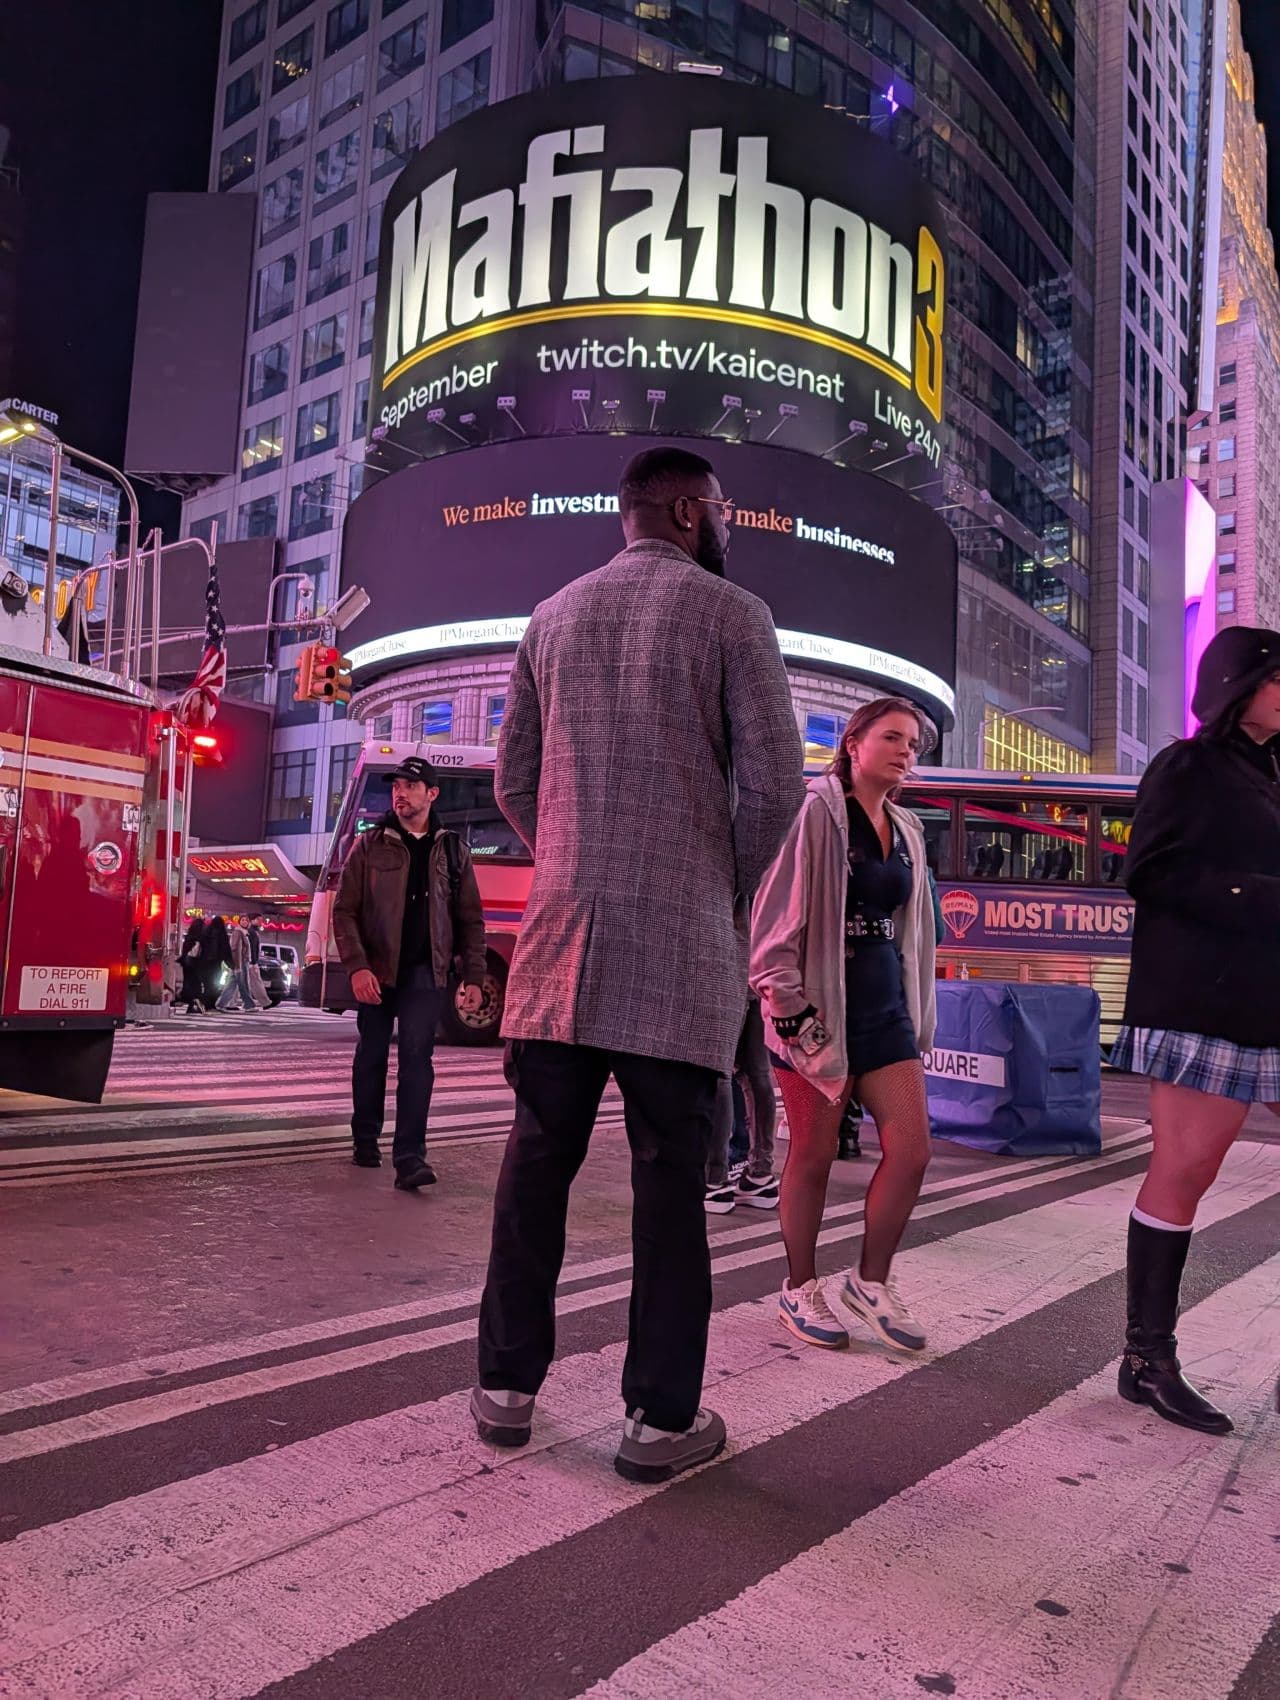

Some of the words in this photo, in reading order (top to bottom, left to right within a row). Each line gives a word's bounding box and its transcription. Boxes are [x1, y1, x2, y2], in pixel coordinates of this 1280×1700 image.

[383, 125, 913, 375] Mafiathon
[915, 226, 944, 423] 3
[537, 337, 845, 403] twitch.tv/kaicenat
[380, 361, 499, 428] September
[12, 398, 59, 425] CARTER
[874, 389, 911, 437] Live
[914, 419, 940, 469] 24/7
[442, 505, 470, 528] We
[472, 496, 527, 523] make
[735, 508, 793, 534] make
[796, 517, 895, 565] businesses
[439, 621, 527, 644] JPMorganChas
[430, 754, 464, 766] 17012
[984, 900, 1057, 931] MOST
[30, 968, 48, 979] TO
[51, 968, 102, 981] REPORT
[47, 983, 56, 994] A
[59, 984, 87, 995] FIRE
[40, 998, 68, 1009] DIAL
[71, 998, 90, 1009] 911
[921, 1050, 979, 1079] QUARE
